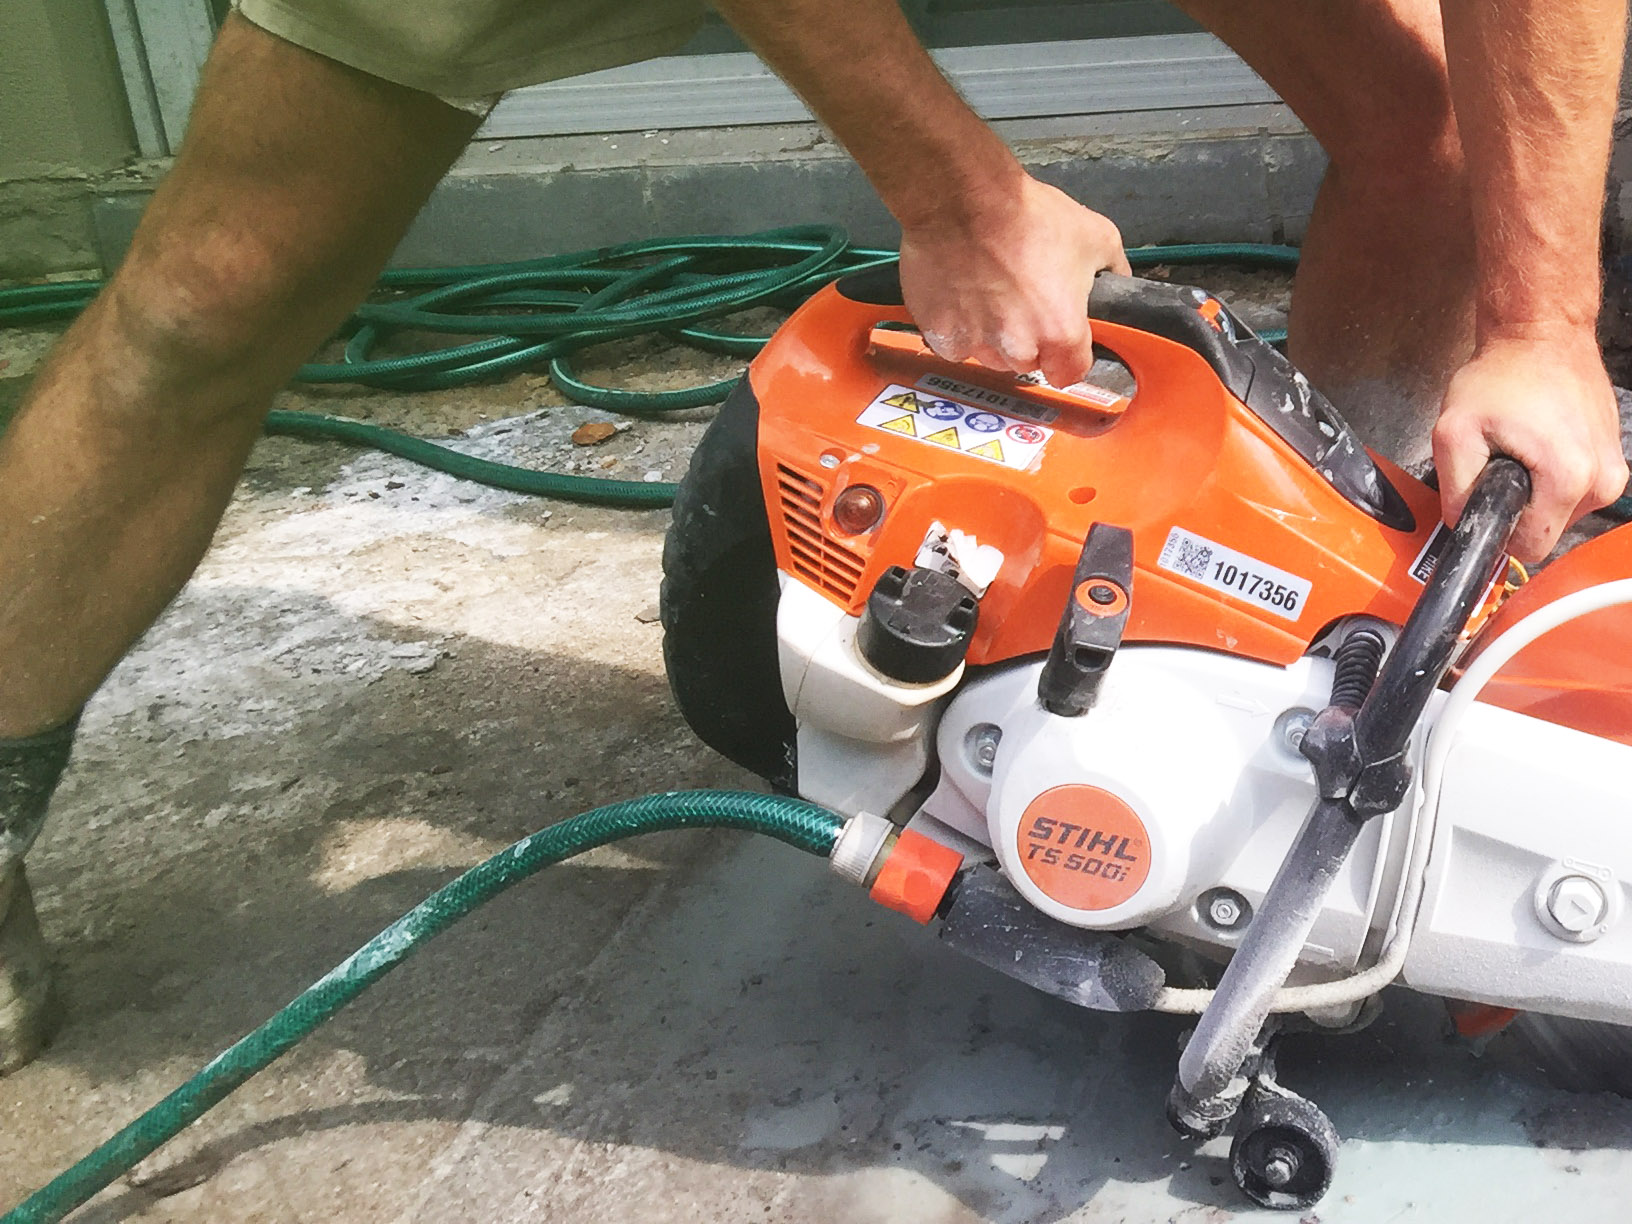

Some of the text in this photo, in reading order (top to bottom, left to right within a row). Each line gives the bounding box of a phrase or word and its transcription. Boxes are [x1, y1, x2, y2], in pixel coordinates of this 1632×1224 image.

[1213, 561, 1299, 611] 1017356
[1028, 817, 1137, 862] STIHL
[1028, 843, 1131, 882] TS 500i
